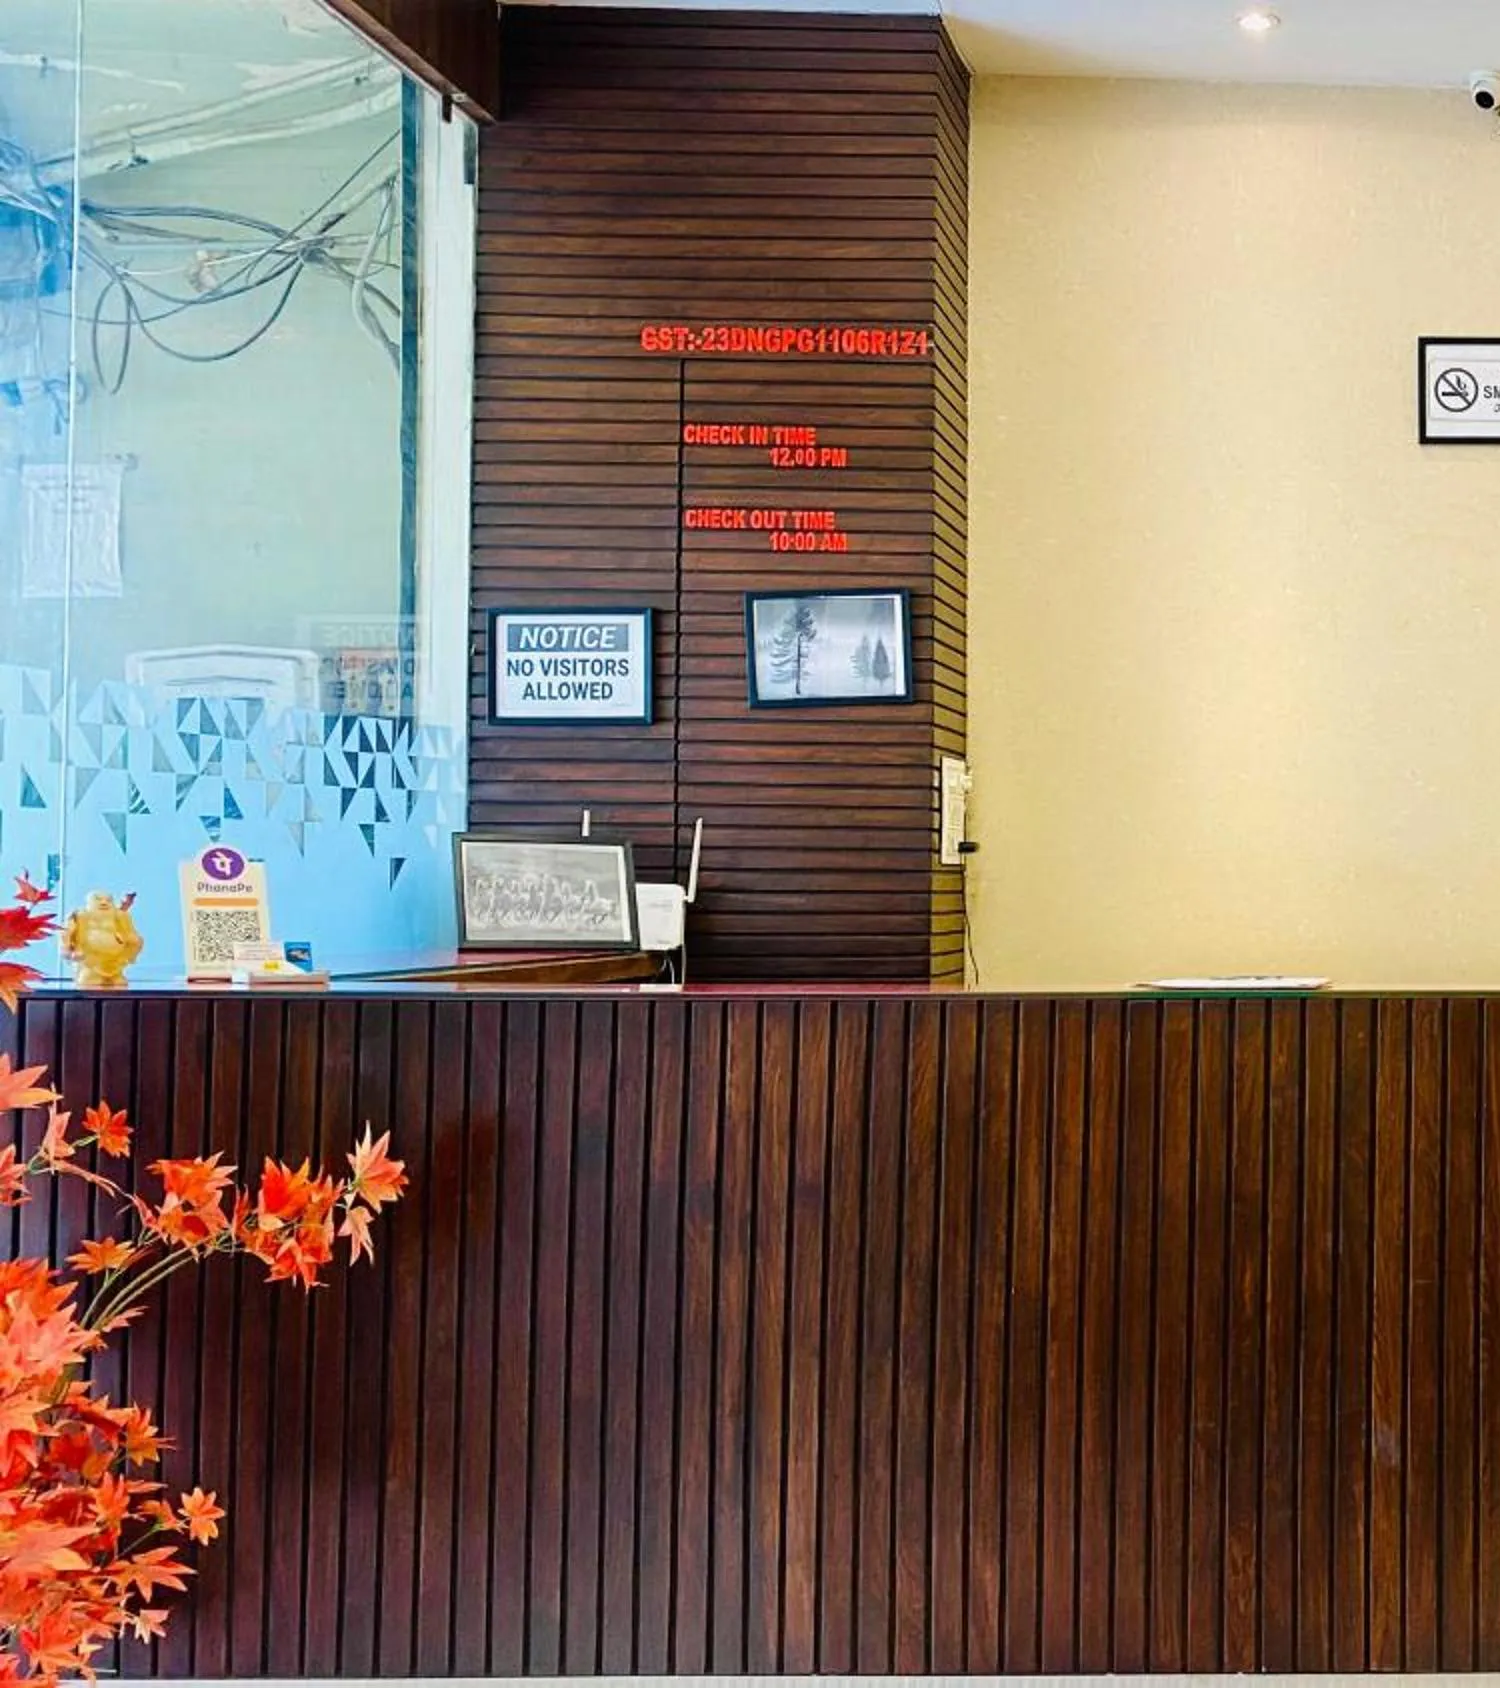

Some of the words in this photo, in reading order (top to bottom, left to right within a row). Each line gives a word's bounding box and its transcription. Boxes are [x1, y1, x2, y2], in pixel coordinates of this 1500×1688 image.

[683, 424, 745, 445] CHECK
[749, 426, 768, 445] IN
[772, 427, 817, 446] TIME
[820, 448, 848, 468] PM
[685, 509, 747, 528] CHECK
[750, 510, 787, 529] OUT
[791, 511, 836, 530] TIME
[819, 533, 848, 552] AM
[519, 626, 617, 649] NOTICE
[507, 659, 534, 676] NO
[539, 659, 629, 677] VISITORS
[522, 682, 613, 700] ALLOWED
